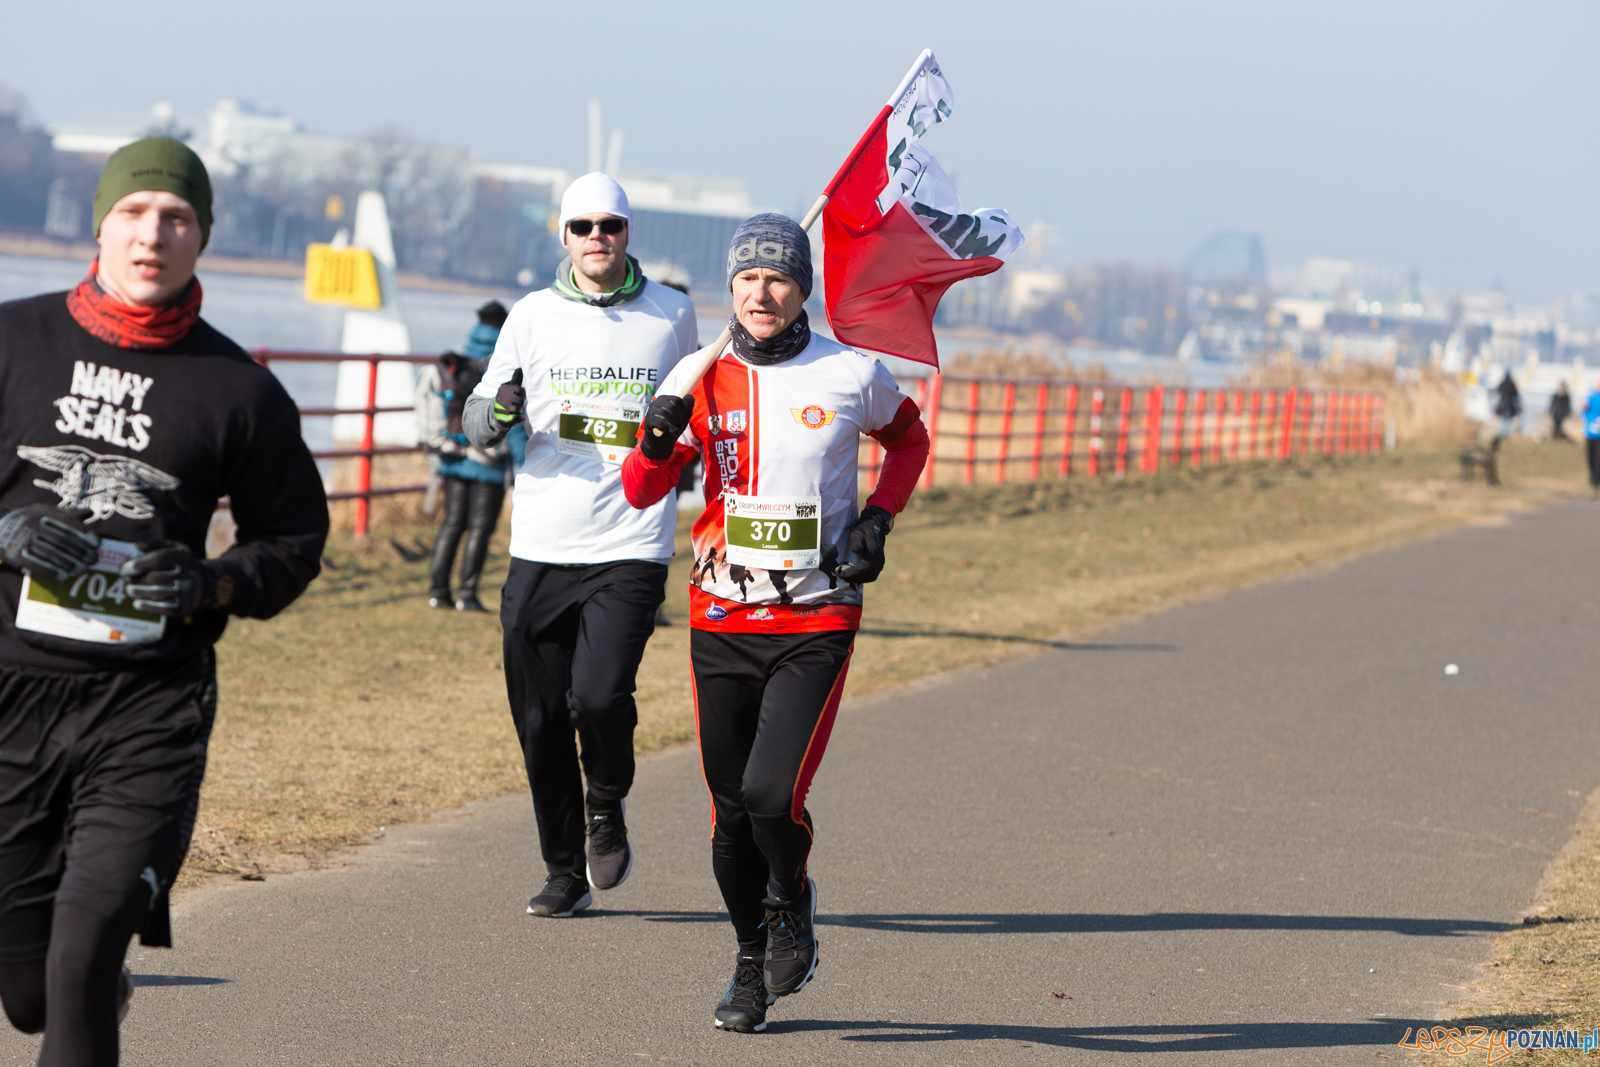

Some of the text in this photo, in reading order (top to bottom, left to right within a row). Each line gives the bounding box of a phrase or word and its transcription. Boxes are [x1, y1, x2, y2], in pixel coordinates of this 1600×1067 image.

[550, 367, 658, 381] HERBALIFE
[70, 360, 154, 411] NAVY
[551, 381, 657, 396] NUTRITION
[53, 396, 152, 452] SEALS
[582, 418, 618, 439] 762
[750, 521, 791, 542] 370
[69, 572, 126, 605] 704
